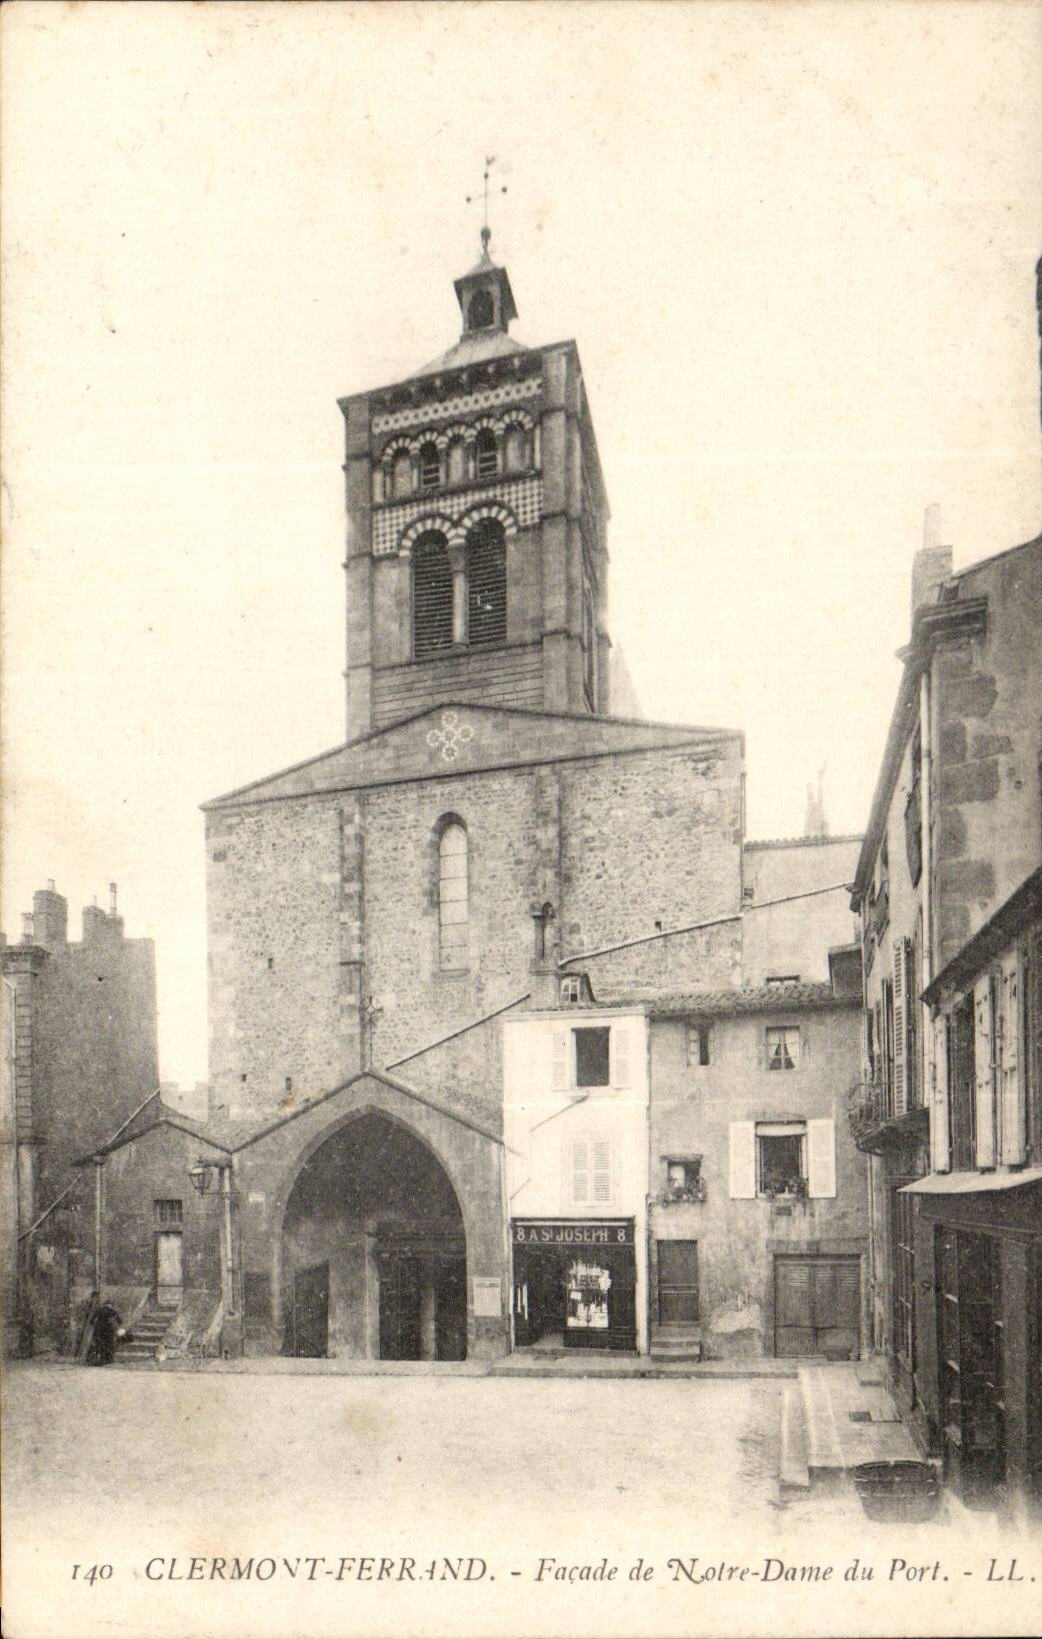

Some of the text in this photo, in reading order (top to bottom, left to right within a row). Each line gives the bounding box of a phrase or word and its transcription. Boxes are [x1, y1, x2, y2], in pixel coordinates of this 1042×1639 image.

[516, 1227, 526, 1242] 8
[529, 1229, 539, 1241] A
[555, 1228, 609, 1242] JOSEPH
[616, 1228, 626, 1242] 8
